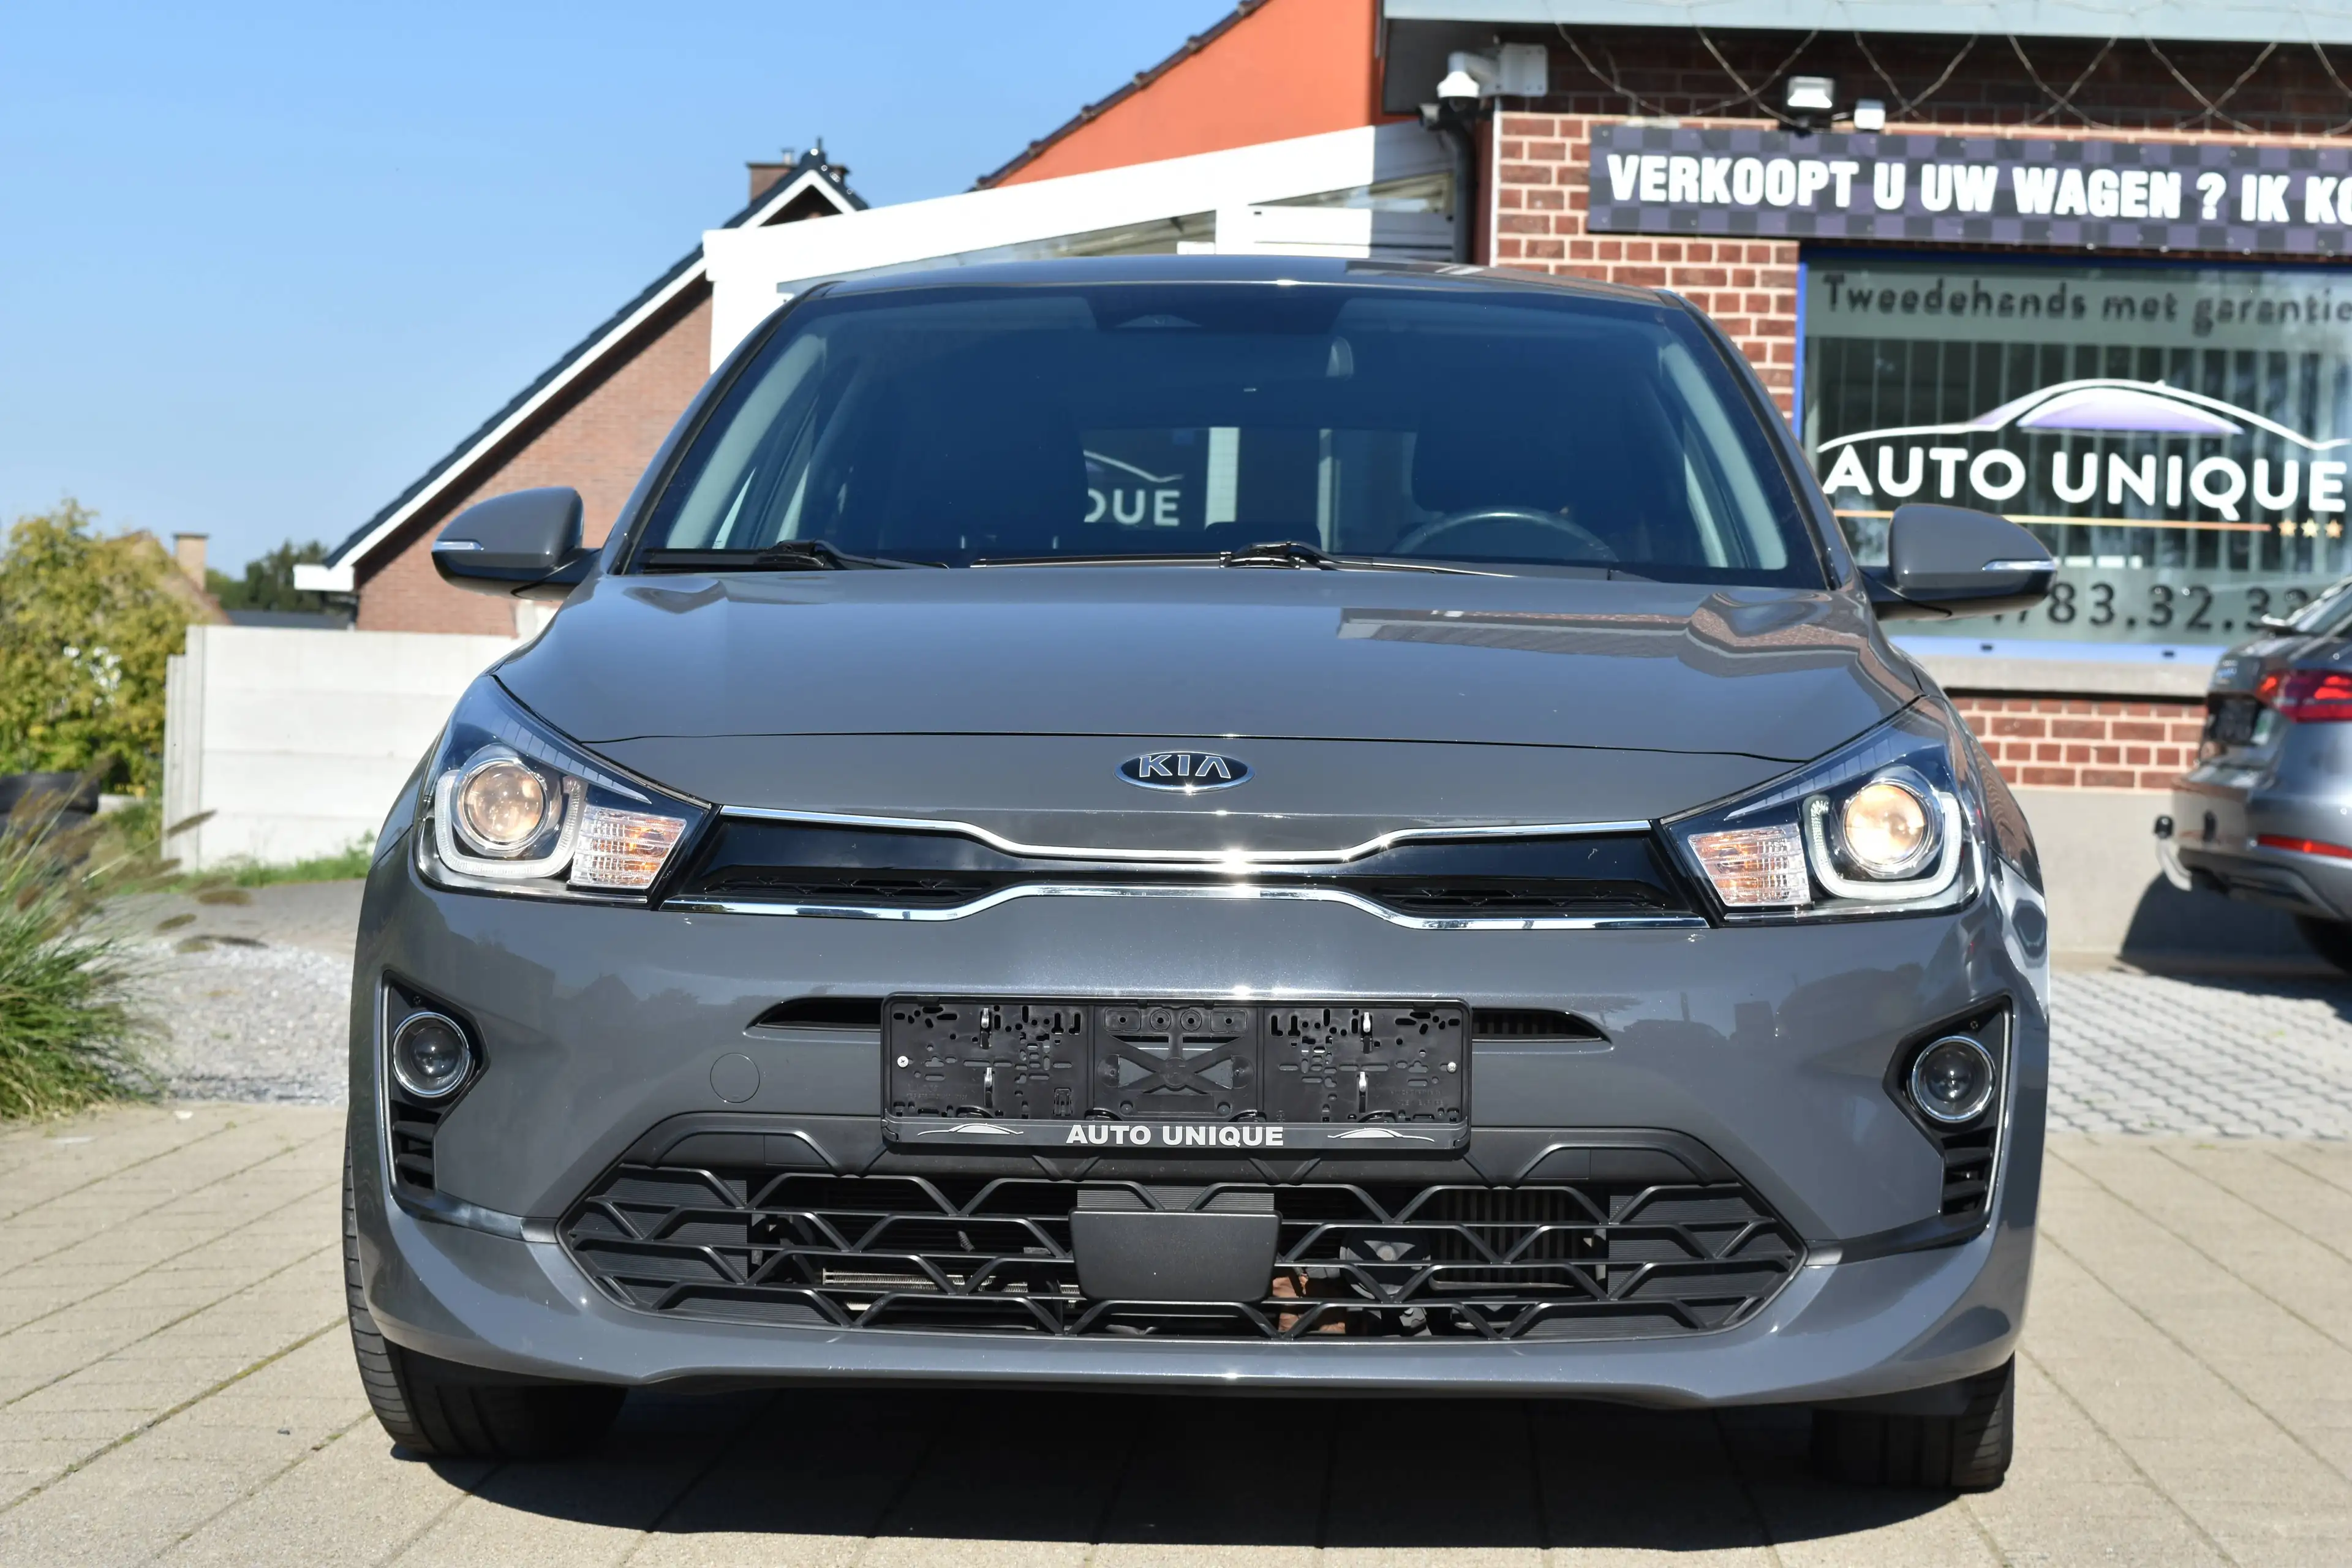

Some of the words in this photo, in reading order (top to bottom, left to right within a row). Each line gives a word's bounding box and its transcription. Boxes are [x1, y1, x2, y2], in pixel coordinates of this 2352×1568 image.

[1607, 154, 1860, 208] VERKOOPT
[1873, 162, 1906, 211] U
[1920, 164, 1999, 213] UW
[2011, 167, 2182, 219] WAGEN
[2196, 172, 2227, 220] ?
[2241, 174, 2291, 223] IK
[1823, 271, 2086, 320] Tweedehands
[2102, 292, 2178, 322] met
[2192, 288, 2352, 338] garantie
[1822, 444, 2026, 500] AUTO
[2052, 451, 2348, 521] UNIQUE
[1139, 755, 1231, 779] KIA
[1066, 1125, 1152, 1145] AUTO
[1163, 1126, 1284, 1147] UNIQUE
